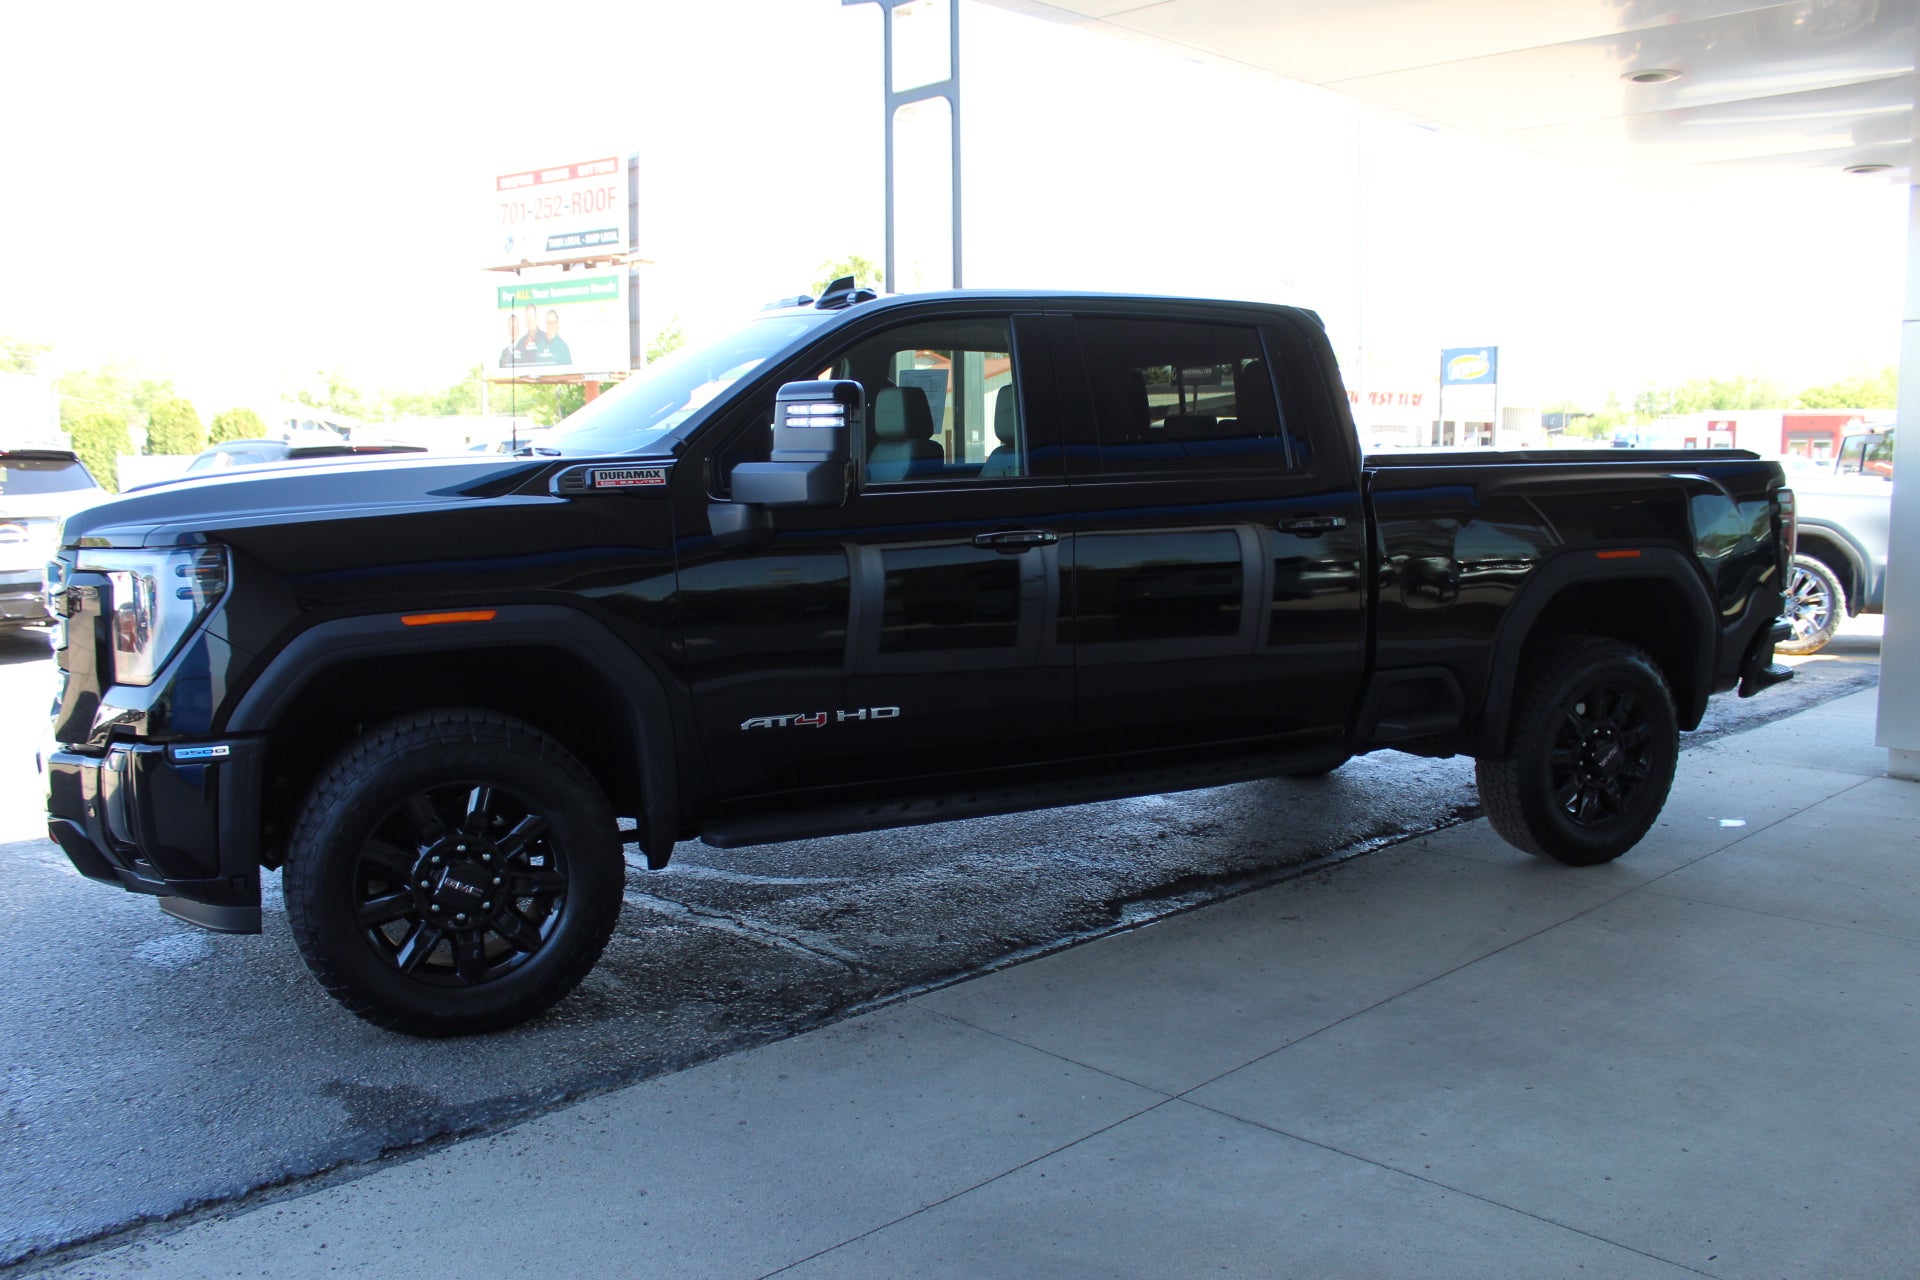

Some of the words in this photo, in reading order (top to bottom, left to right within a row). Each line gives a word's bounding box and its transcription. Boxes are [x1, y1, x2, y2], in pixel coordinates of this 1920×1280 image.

[501, 186, 617, 225] 701-252-ROOF
[515, 289, 532, 301] ALL
[600, 470, 661, 480] DURAMAX
[741, 711, 827, 730] AT4
[836, 706, 900, 722] HD
[444, 877, 484, 898] GMC
